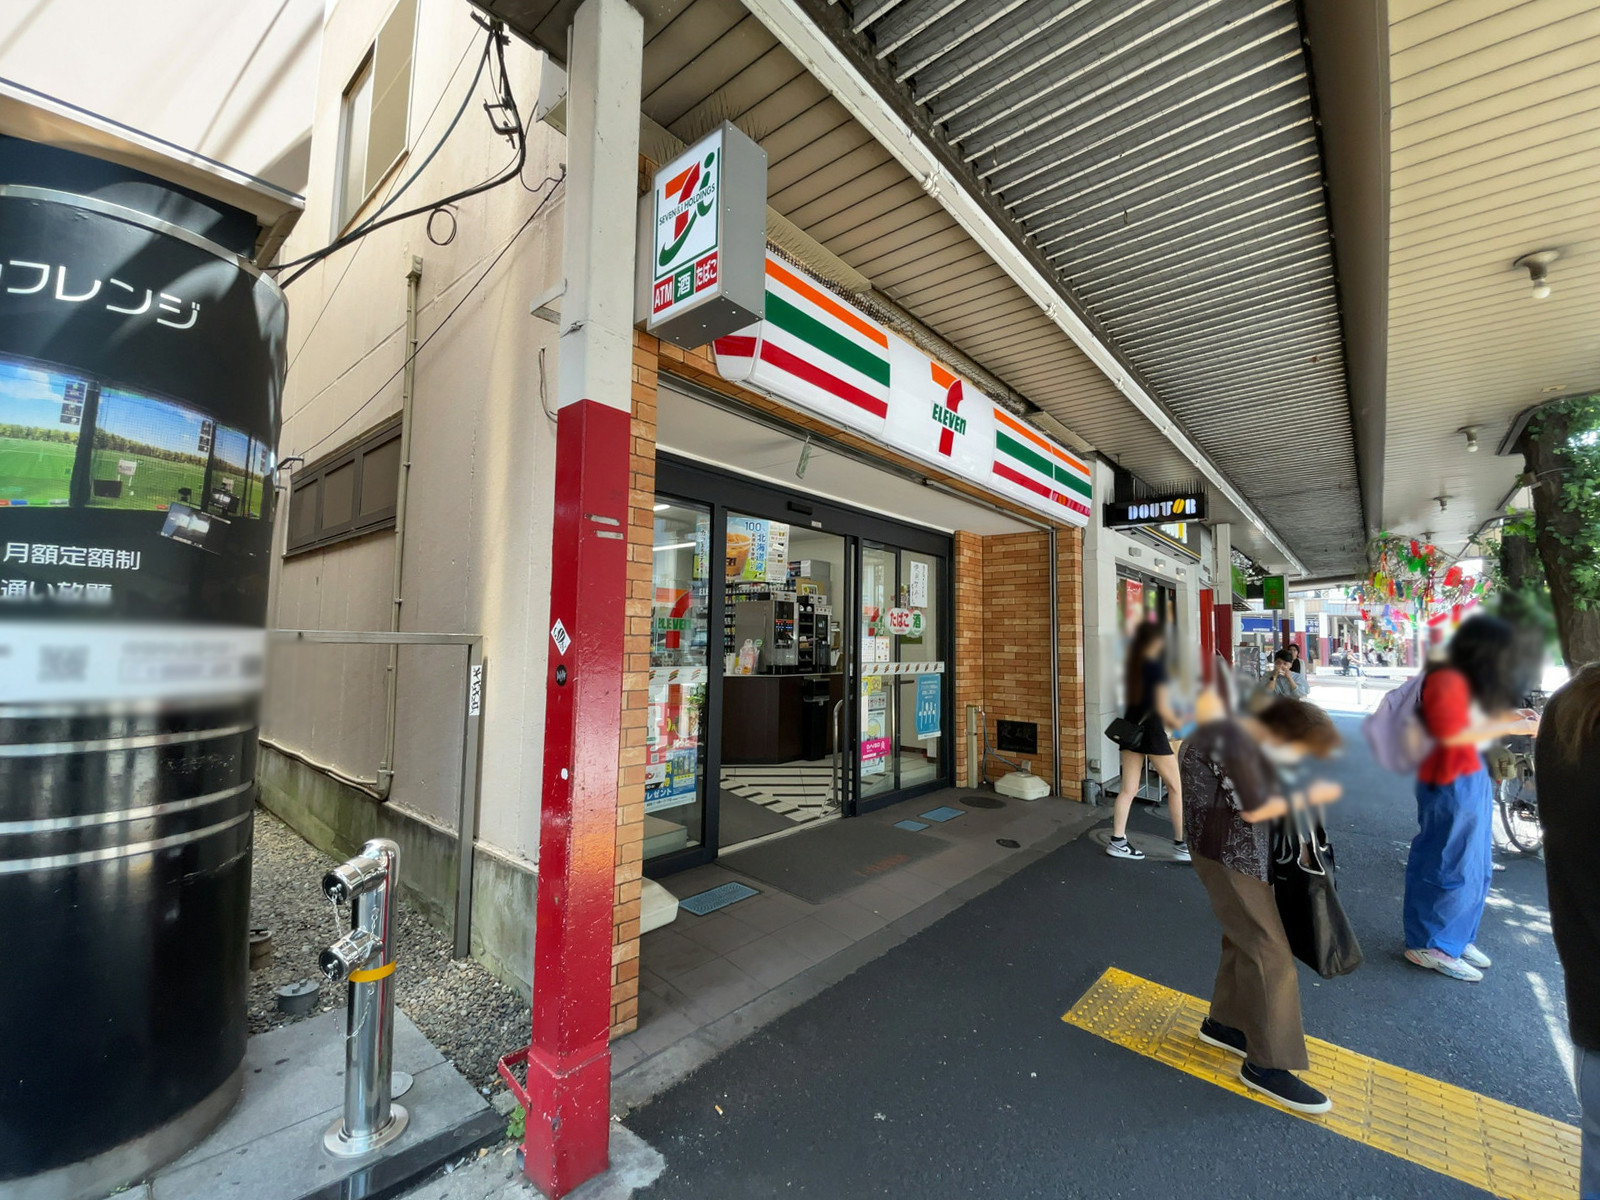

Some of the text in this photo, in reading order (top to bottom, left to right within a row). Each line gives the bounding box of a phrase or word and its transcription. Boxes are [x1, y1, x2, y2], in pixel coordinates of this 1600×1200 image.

[684, 185, 716, 210] HOLDINGS
[677, 271, 692, 298] 酒
[695, 258, 717, 287] たばこ
[0, 260, 201, 330] フレンジ
[654, 281, 673, 309] ATM
[1127, 498, 1197, 521] DOUTOR
[3, 542, 141, 570] 月額定額制
[889, 611, 922, 629] たばこ 酒
[645, 788, 672, 800] レゼント
